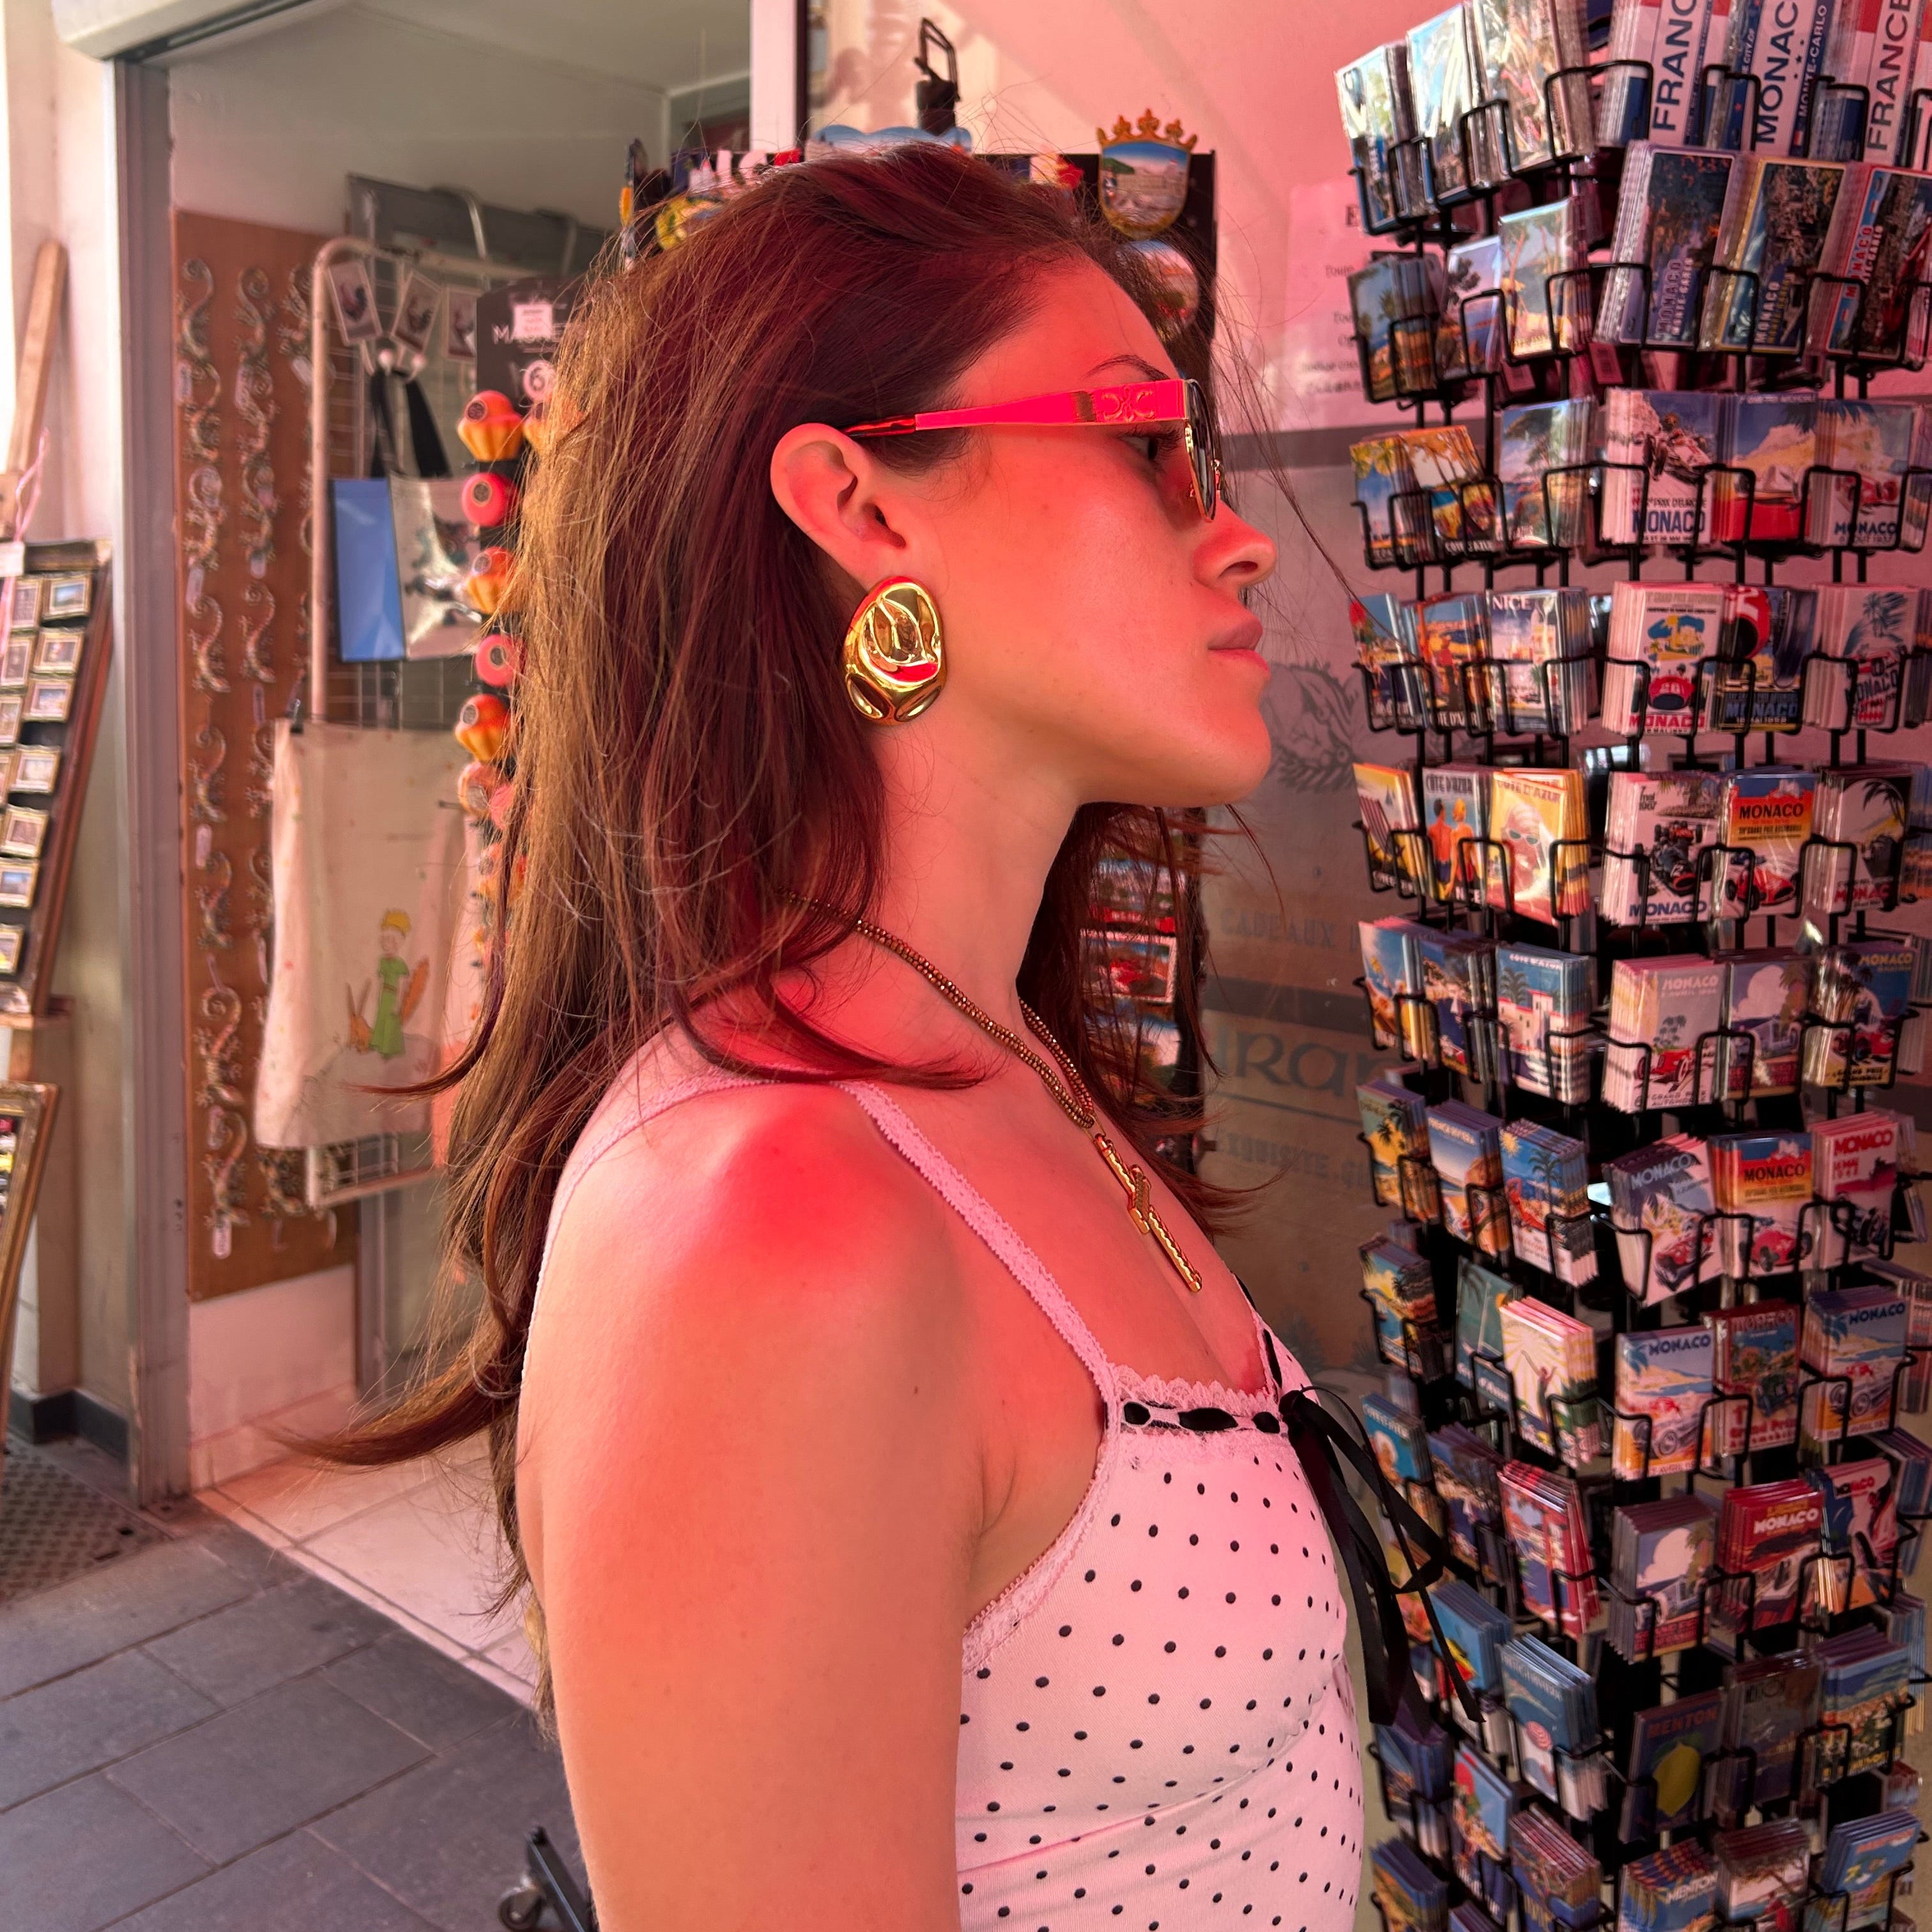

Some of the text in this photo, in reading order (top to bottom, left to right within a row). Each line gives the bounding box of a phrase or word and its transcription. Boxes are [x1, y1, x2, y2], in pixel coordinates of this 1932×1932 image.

[1799, 5, 1827, 118] MONTE-CARLO
[1754, 282, 1780, 343] MONACO
[1632, 510, 1705, 533] MONACO
[1492, 595, 1531, 610] NICE
[1739, 802, 1804, 820] MONACO
[1629, 900, 1706, 917] MONACO
[1221, 907, 1337, 950] CADEAUX
[1662, 974, 1719, 992] MONACO
[1834, 1129, 1894, 1156] MONACO
[1631, 1153, 1692, 1190] MONACO
[1744, 1163, 1805, 1183] MONACO
[1848, 1302, 1906, 1325] MONACO
[1648, 1335, 1711, 1356] MONACO
[1752, 1508, 1820, 1534] MONACO
[1647, 1706, 1718, 1739] MENTON
